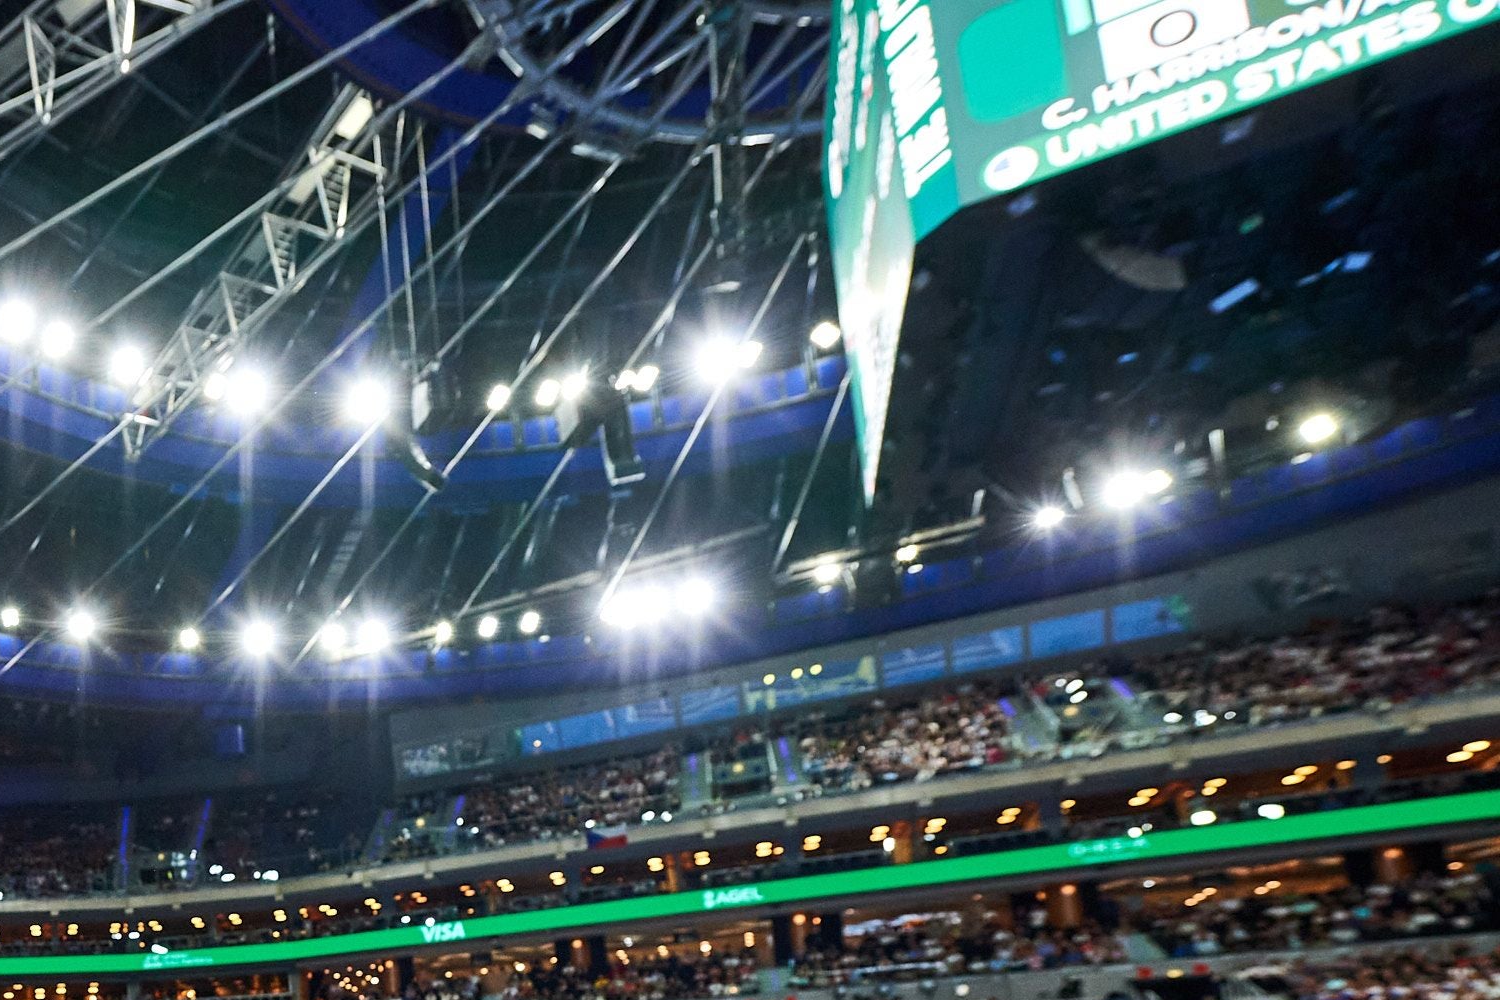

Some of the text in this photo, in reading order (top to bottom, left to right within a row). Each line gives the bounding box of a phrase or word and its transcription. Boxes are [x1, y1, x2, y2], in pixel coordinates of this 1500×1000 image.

[1045, 79, 1228, 168] UNITED
[1233, 0, 1442, 102] STATES
[420, 921, 467, 942] VISA
